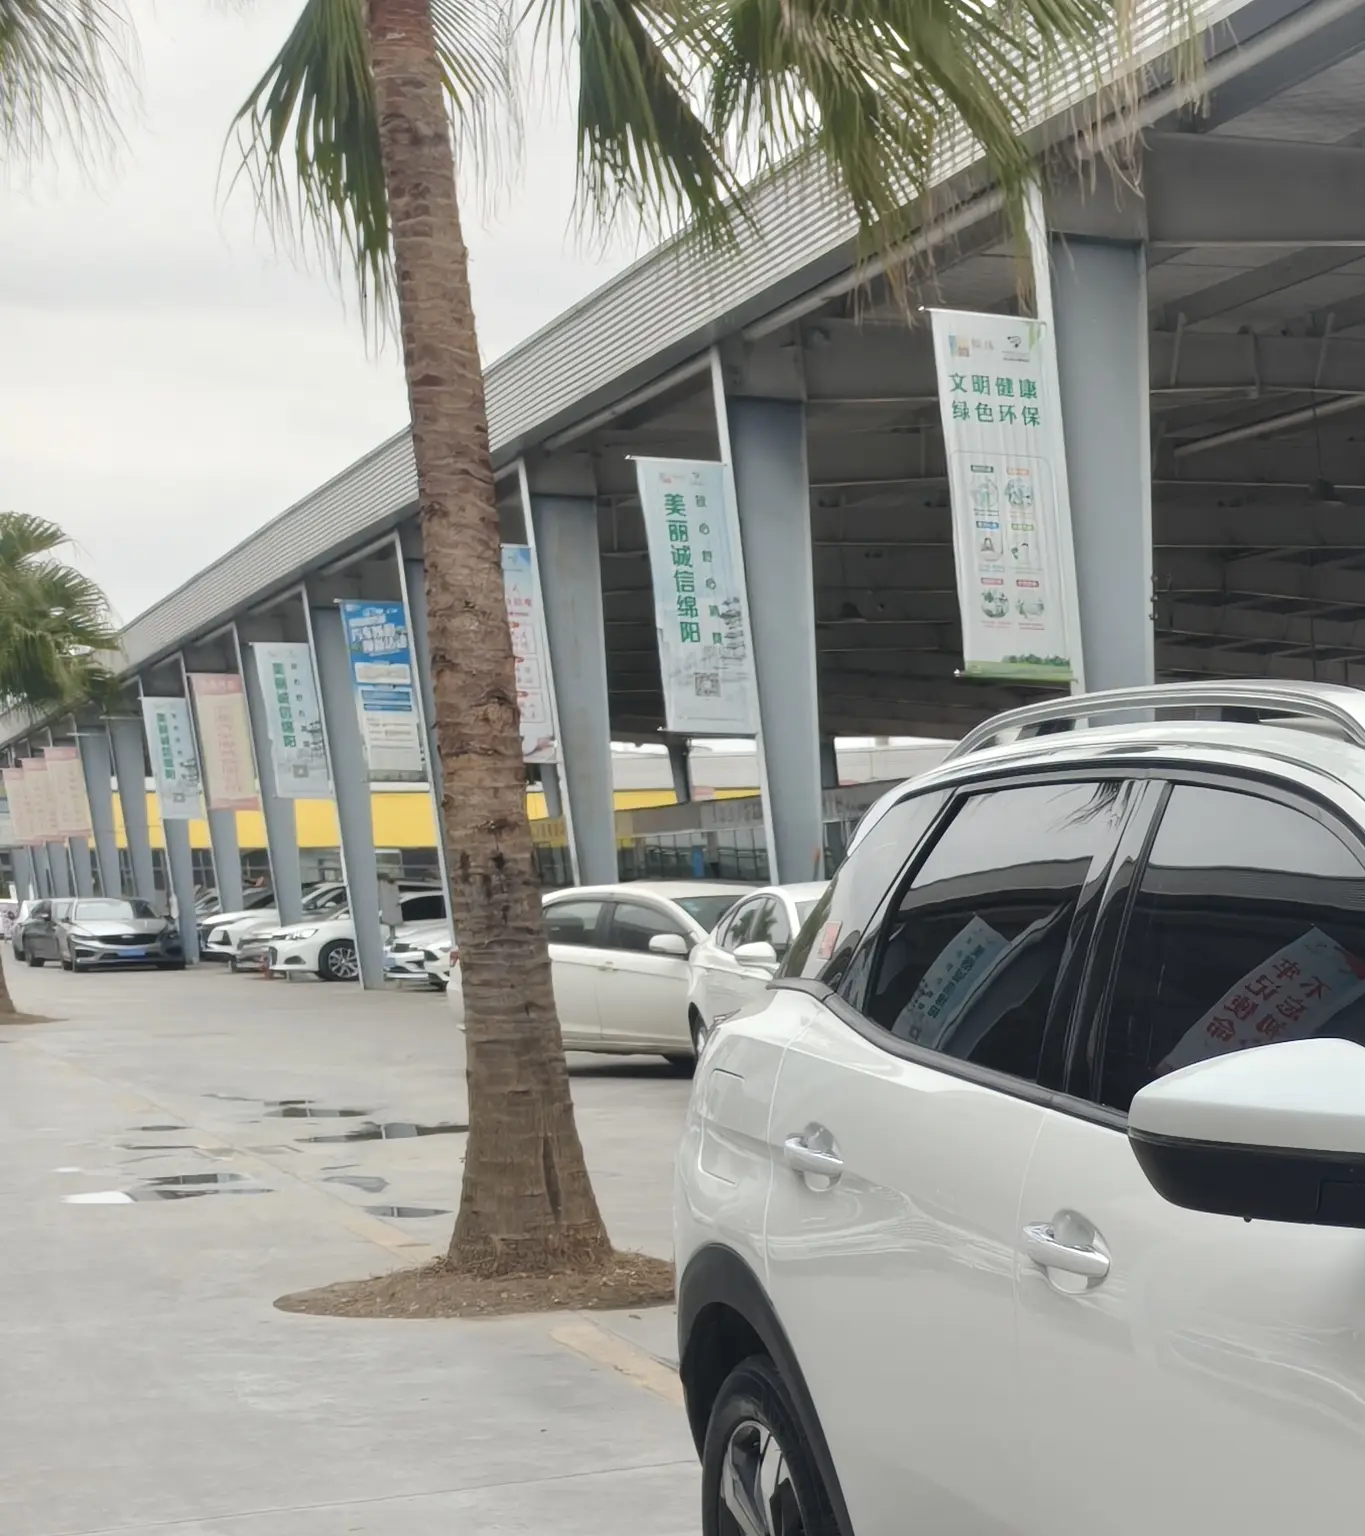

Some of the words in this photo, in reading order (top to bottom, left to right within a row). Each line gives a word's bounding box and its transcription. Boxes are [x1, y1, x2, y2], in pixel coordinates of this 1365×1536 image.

[948, 373, 1038, 399] 文明健康
[952, 400, 1041, 427] 绿色环保
[664, 493, 701, 643] 美丽诚信绵阳
